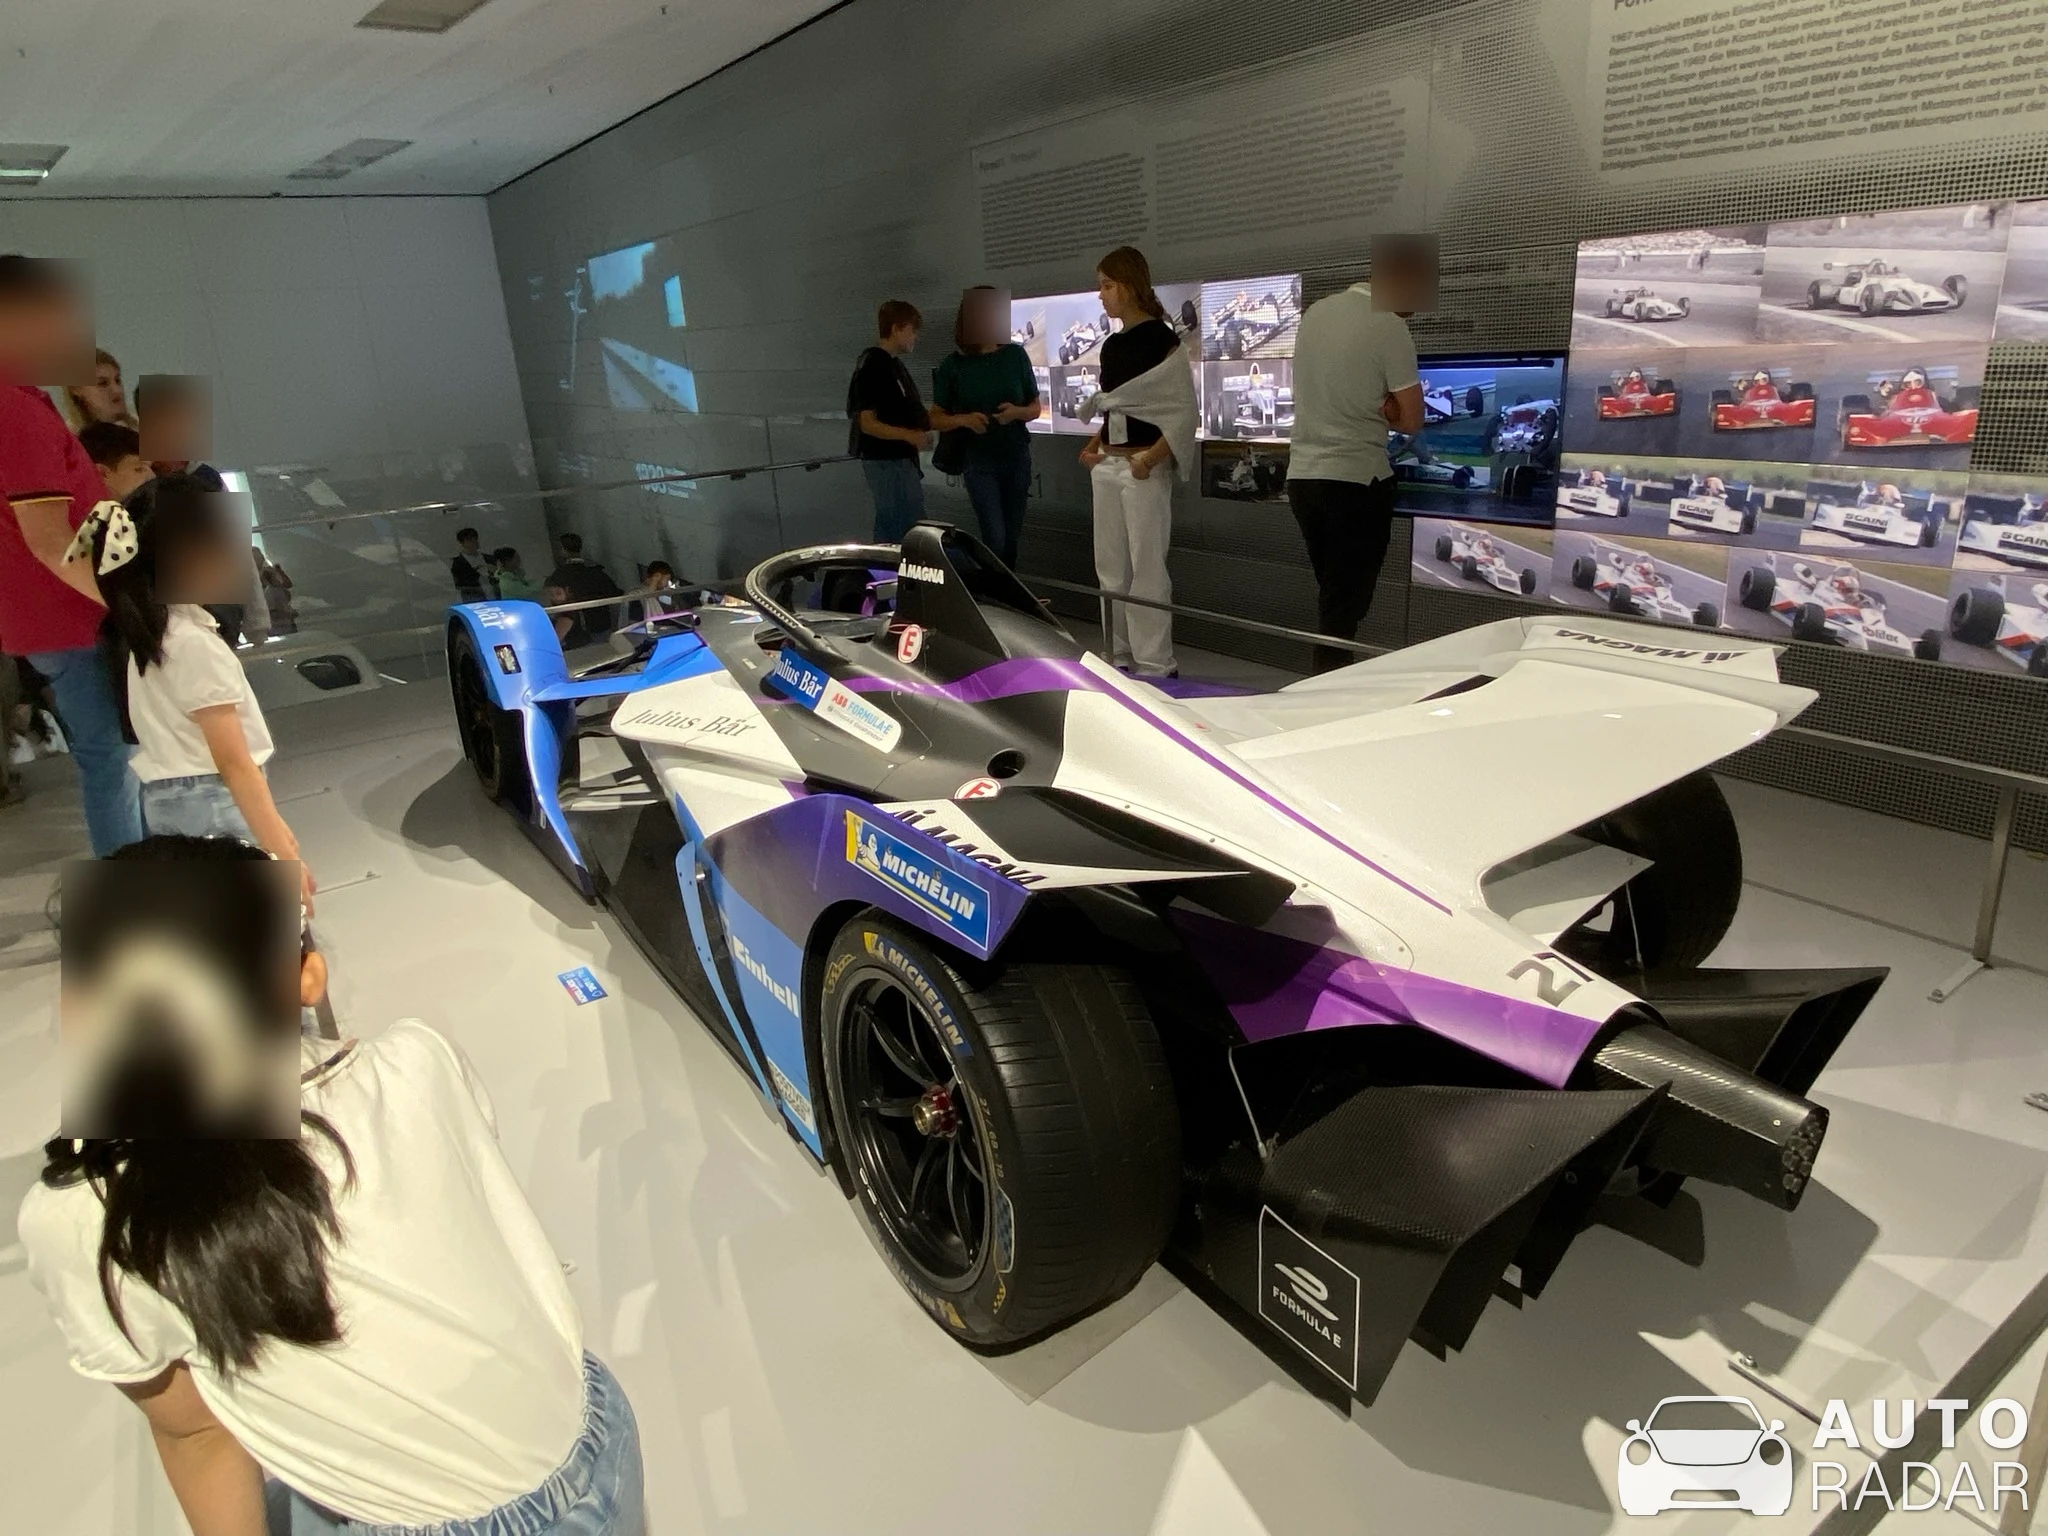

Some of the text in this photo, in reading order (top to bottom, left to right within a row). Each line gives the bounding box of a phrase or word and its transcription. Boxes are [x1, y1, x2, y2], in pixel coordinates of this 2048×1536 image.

[1682, 14, 1708, 27] BMW
[1719, 100, 1759, 113] MARCH
[1898, 71, 1943, 83] Partner
[1810, 71, 1840, 85] BMW
[1692, 120, 1718, 131] BMW
[1869, 121, 1901, 133] BMW
[1904, 112, 1972, 128] Motorsport
[907, 564, 944, 585] MAGNA
[903, 631, 918, 657] E
[1553, 629, 1701, 660] MAGNA
[798, 670, 823, 698] Bär
[832, 693, 849, 708] ABB
[622, 708, 756, 738] Julius Bär
[922, 825, 1048, 886] MAGNA
[882, 853, 976, 921] MICHELIN
[732, 935, 800, 1018] Einhell
[1506, 952, 1594, 1008] 27
[888, 947, 964, 1046] MICHELIN
[1272, 1285, 1342, 1349] FORMULA E
